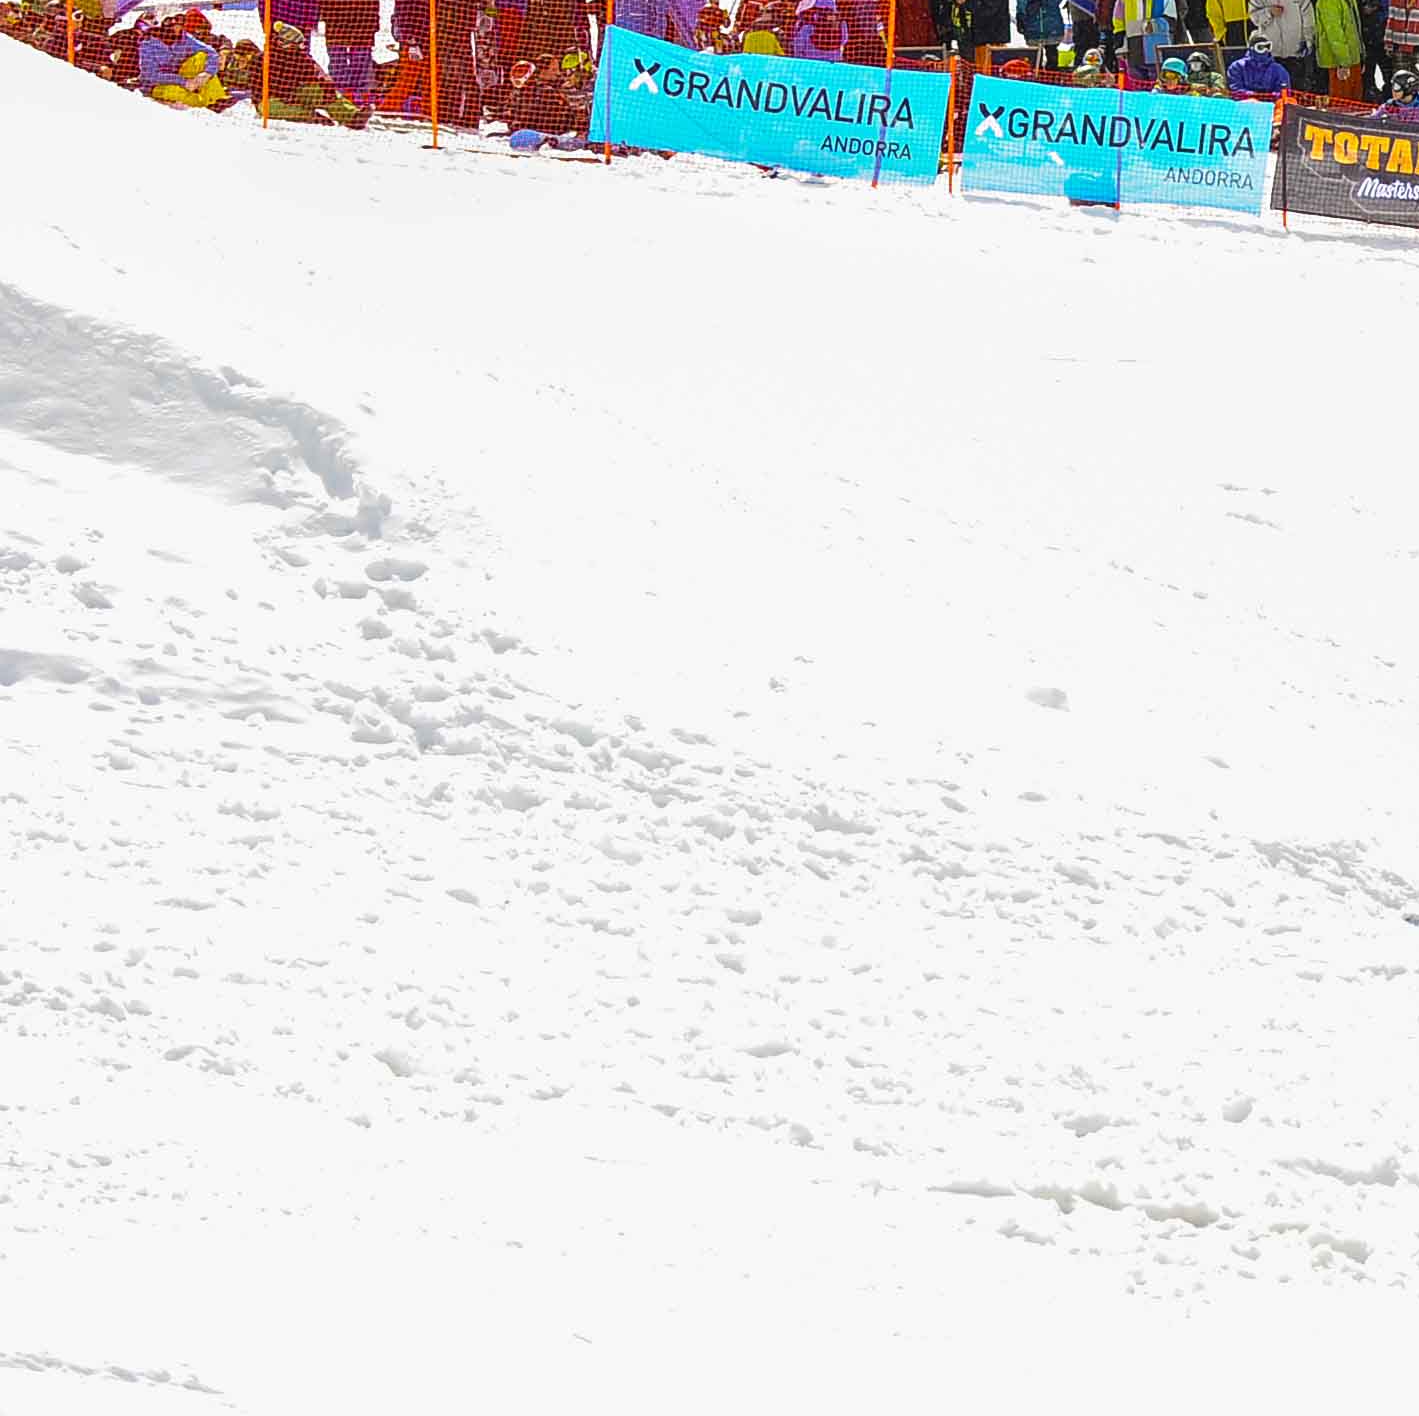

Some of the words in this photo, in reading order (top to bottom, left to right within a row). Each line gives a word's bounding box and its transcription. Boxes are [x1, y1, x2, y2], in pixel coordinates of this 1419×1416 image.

[662, 67, 915, 130] GRANDVALIRA
[820, 134, 912, 162] ANDORRA
[1008, 108, 1256, 159] GRANDVALIRA
[1163, 164, 1255, 191] ANDORRA
